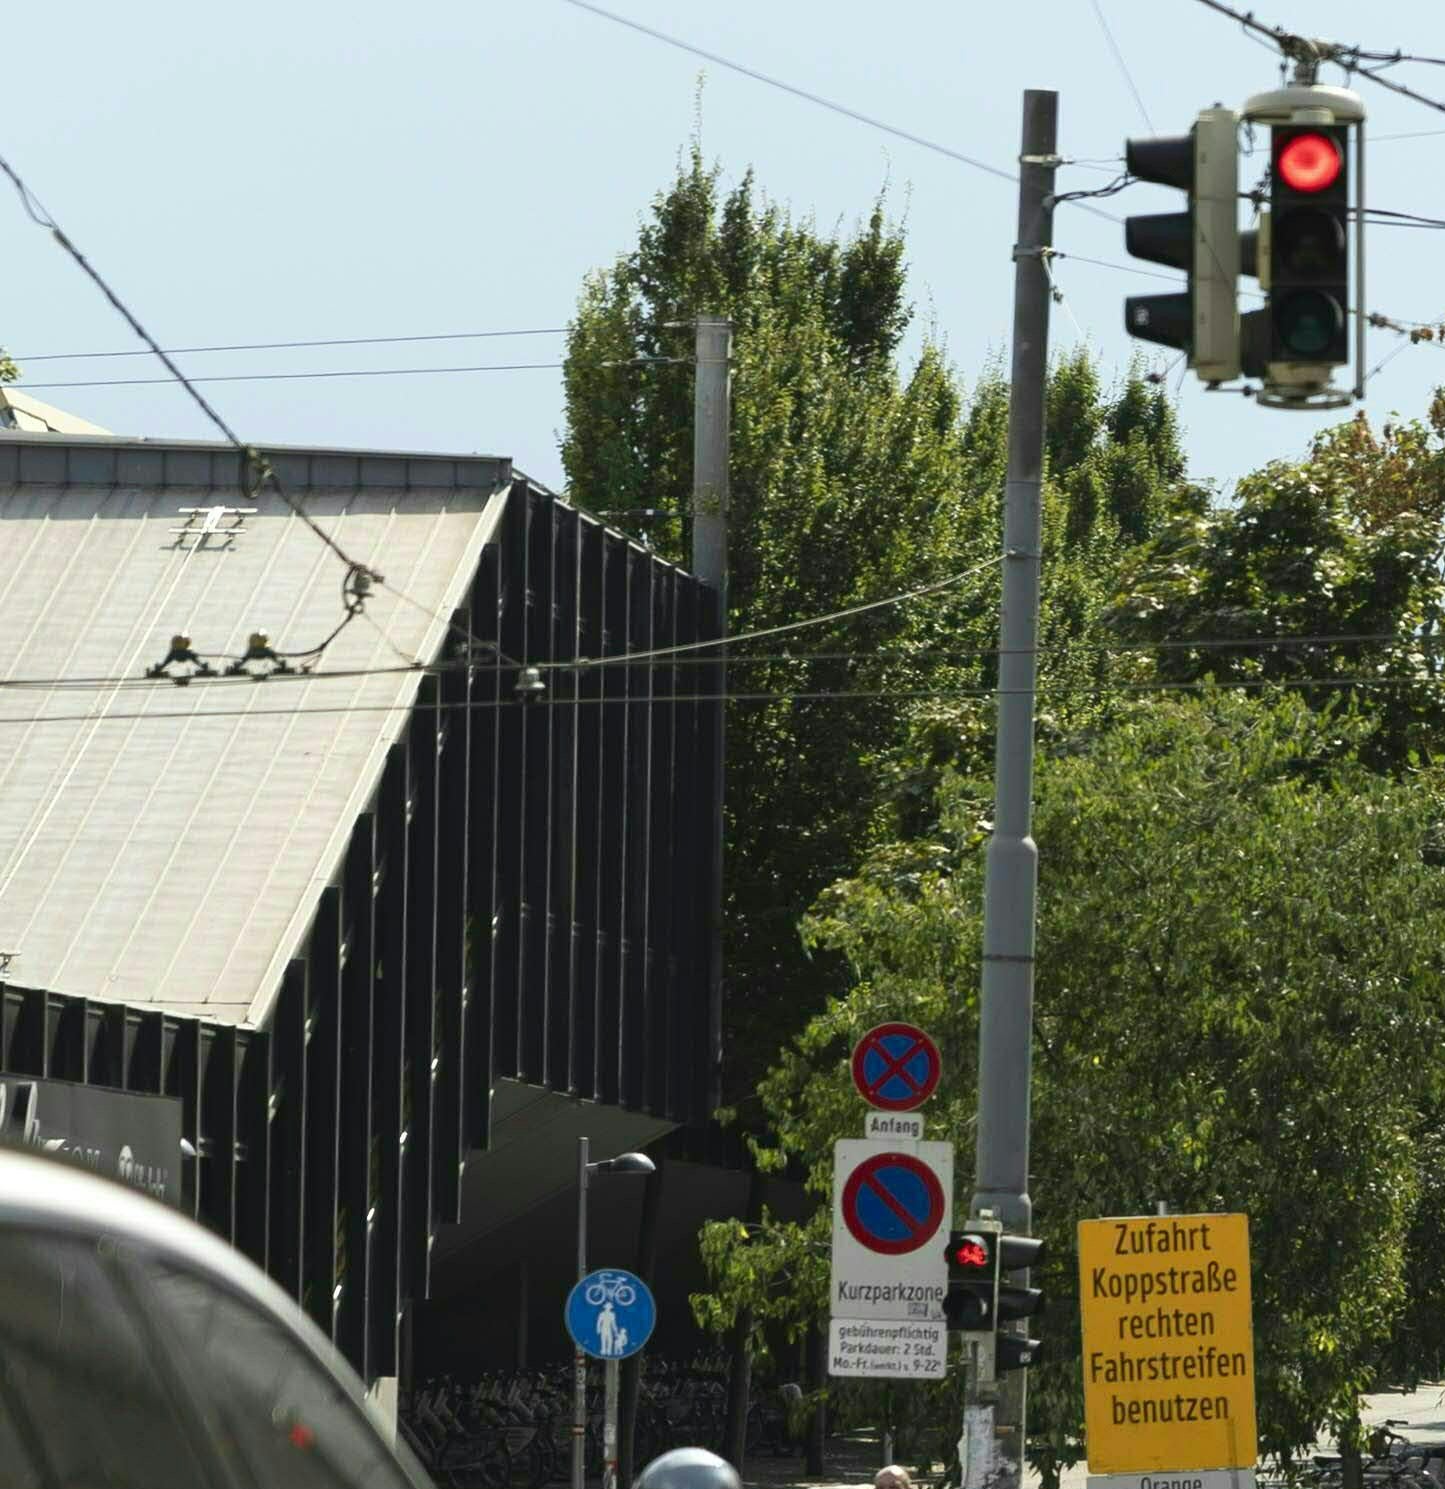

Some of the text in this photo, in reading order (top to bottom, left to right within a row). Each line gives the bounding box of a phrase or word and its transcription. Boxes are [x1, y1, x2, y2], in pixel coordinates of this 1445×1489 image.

[870, 1117, 919, 1136] Anfang
[1114, 1223, 1211, 1255] Zufahrt
[839, 1281, 944, 1304] Kurzparkzone
[1092, 1261, 1238, 1303] Koppstraße
[838, 1326, 939, 1343] gebührenpflichtig
[1118, 1308, 1215, 1340] rechten
[840, 1342, 936, 1356] Parkdauer: 2 Std.
[1091, 1347, 1246, 1384] Fahrstreifen
[1112, 1395, 1229, 1425] benutzen
